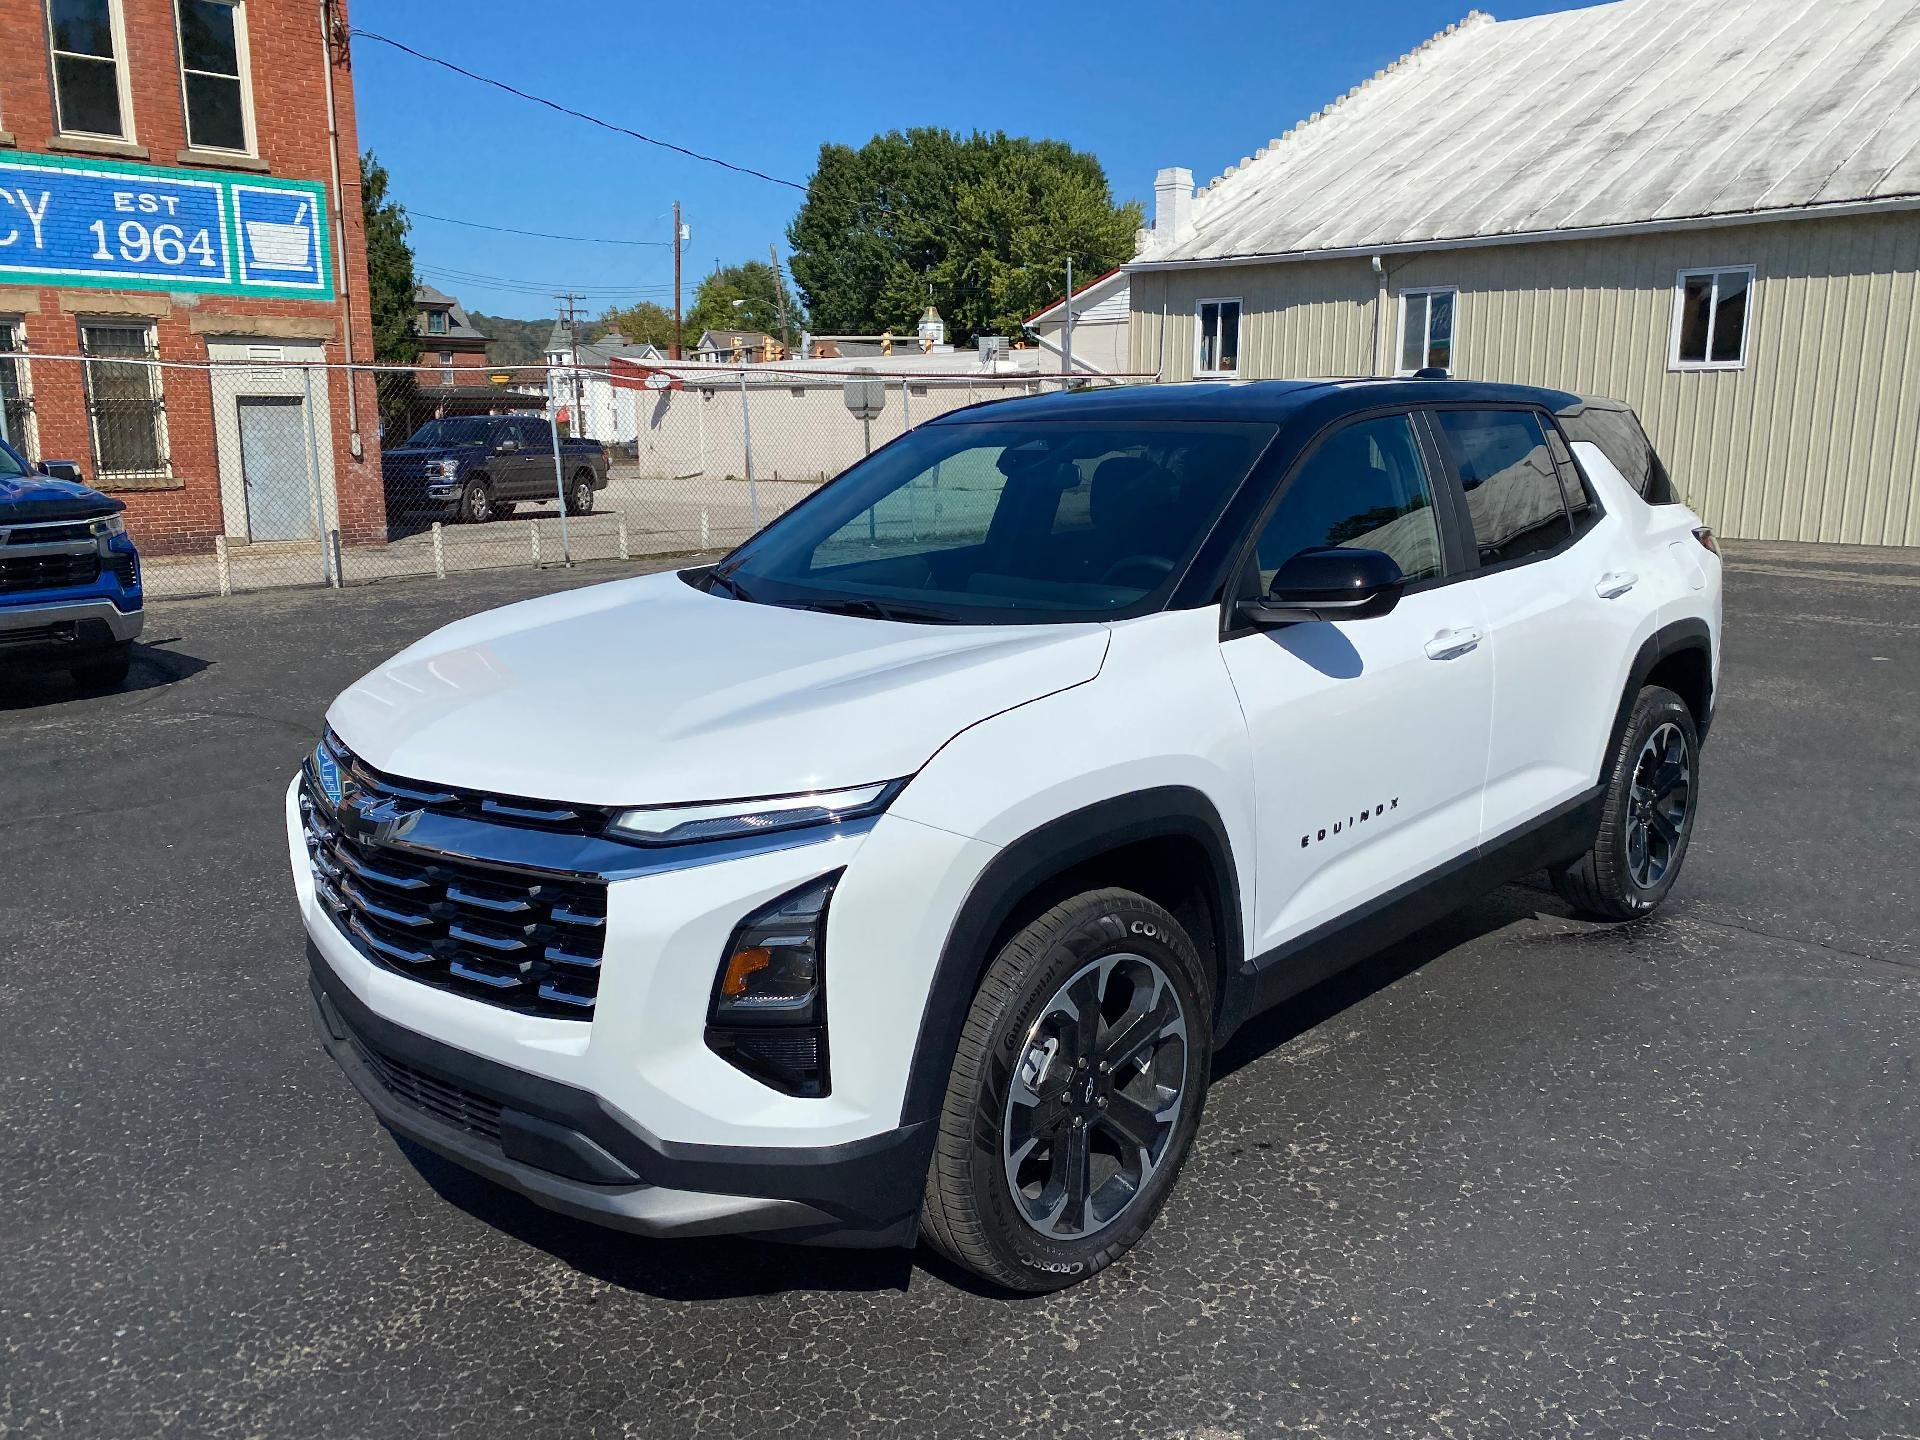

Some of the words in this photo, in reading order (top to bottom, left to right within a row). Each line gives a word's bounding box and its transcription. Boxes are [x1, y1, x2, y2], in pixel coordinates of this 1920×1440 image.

[113, 191, 180, 216] EST
[89, 219, 217, 267] 1964
[1300, 797, 1399, 848] EQUINOX
